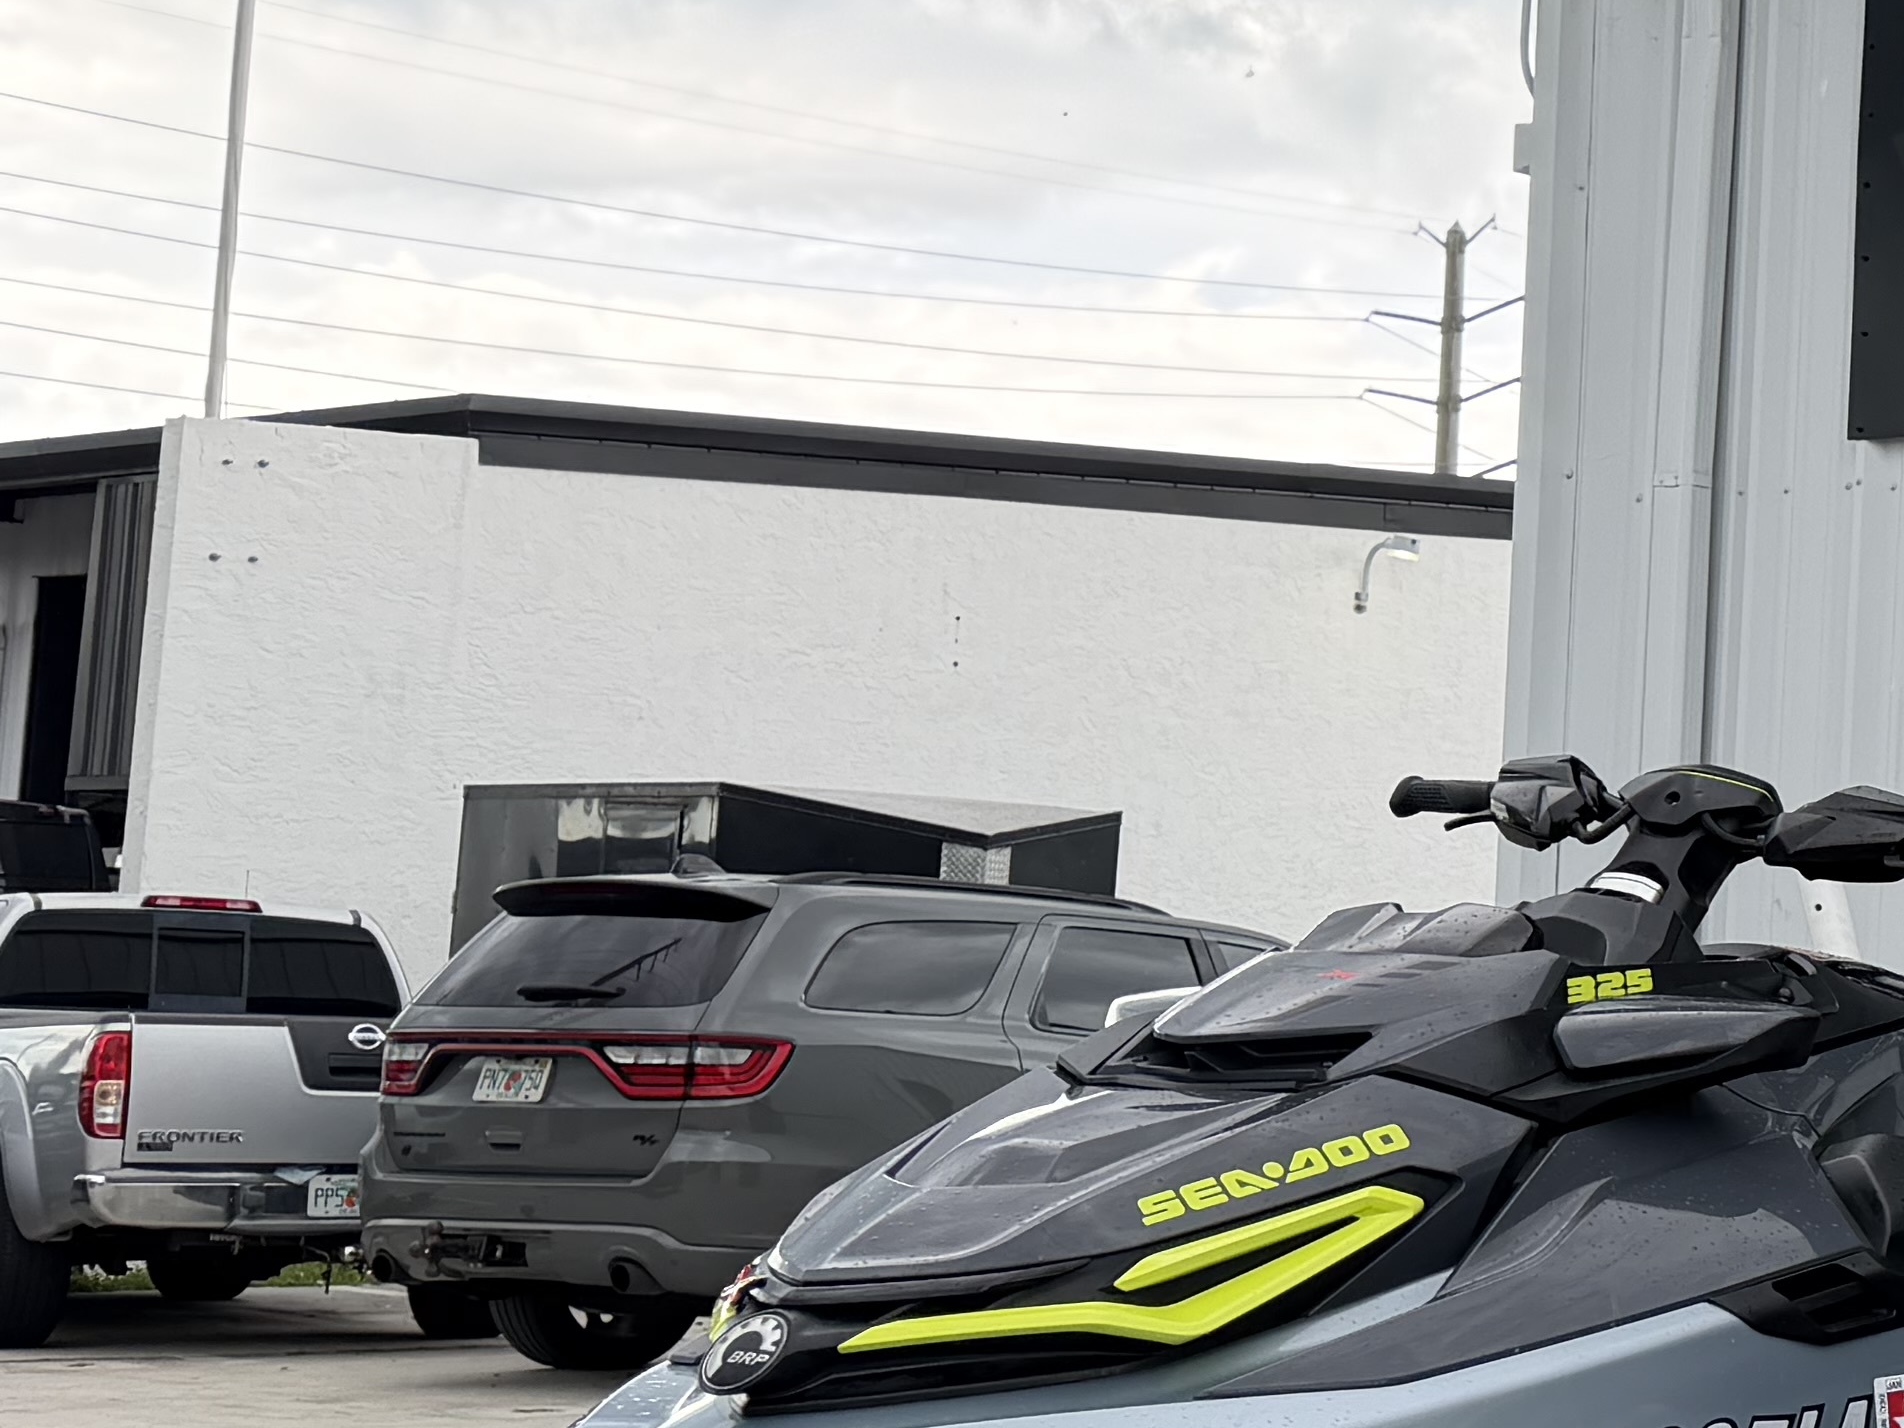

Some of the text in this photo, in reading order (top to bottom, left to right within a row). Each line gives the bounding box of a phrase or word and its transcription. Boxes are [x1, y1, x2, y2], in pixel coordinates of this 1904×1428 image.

[1566, 968, 1653, 1004] 325
[138, 1129, 243, 1143] FRONTIER
[726, 1350, 770, 1365] BRP
